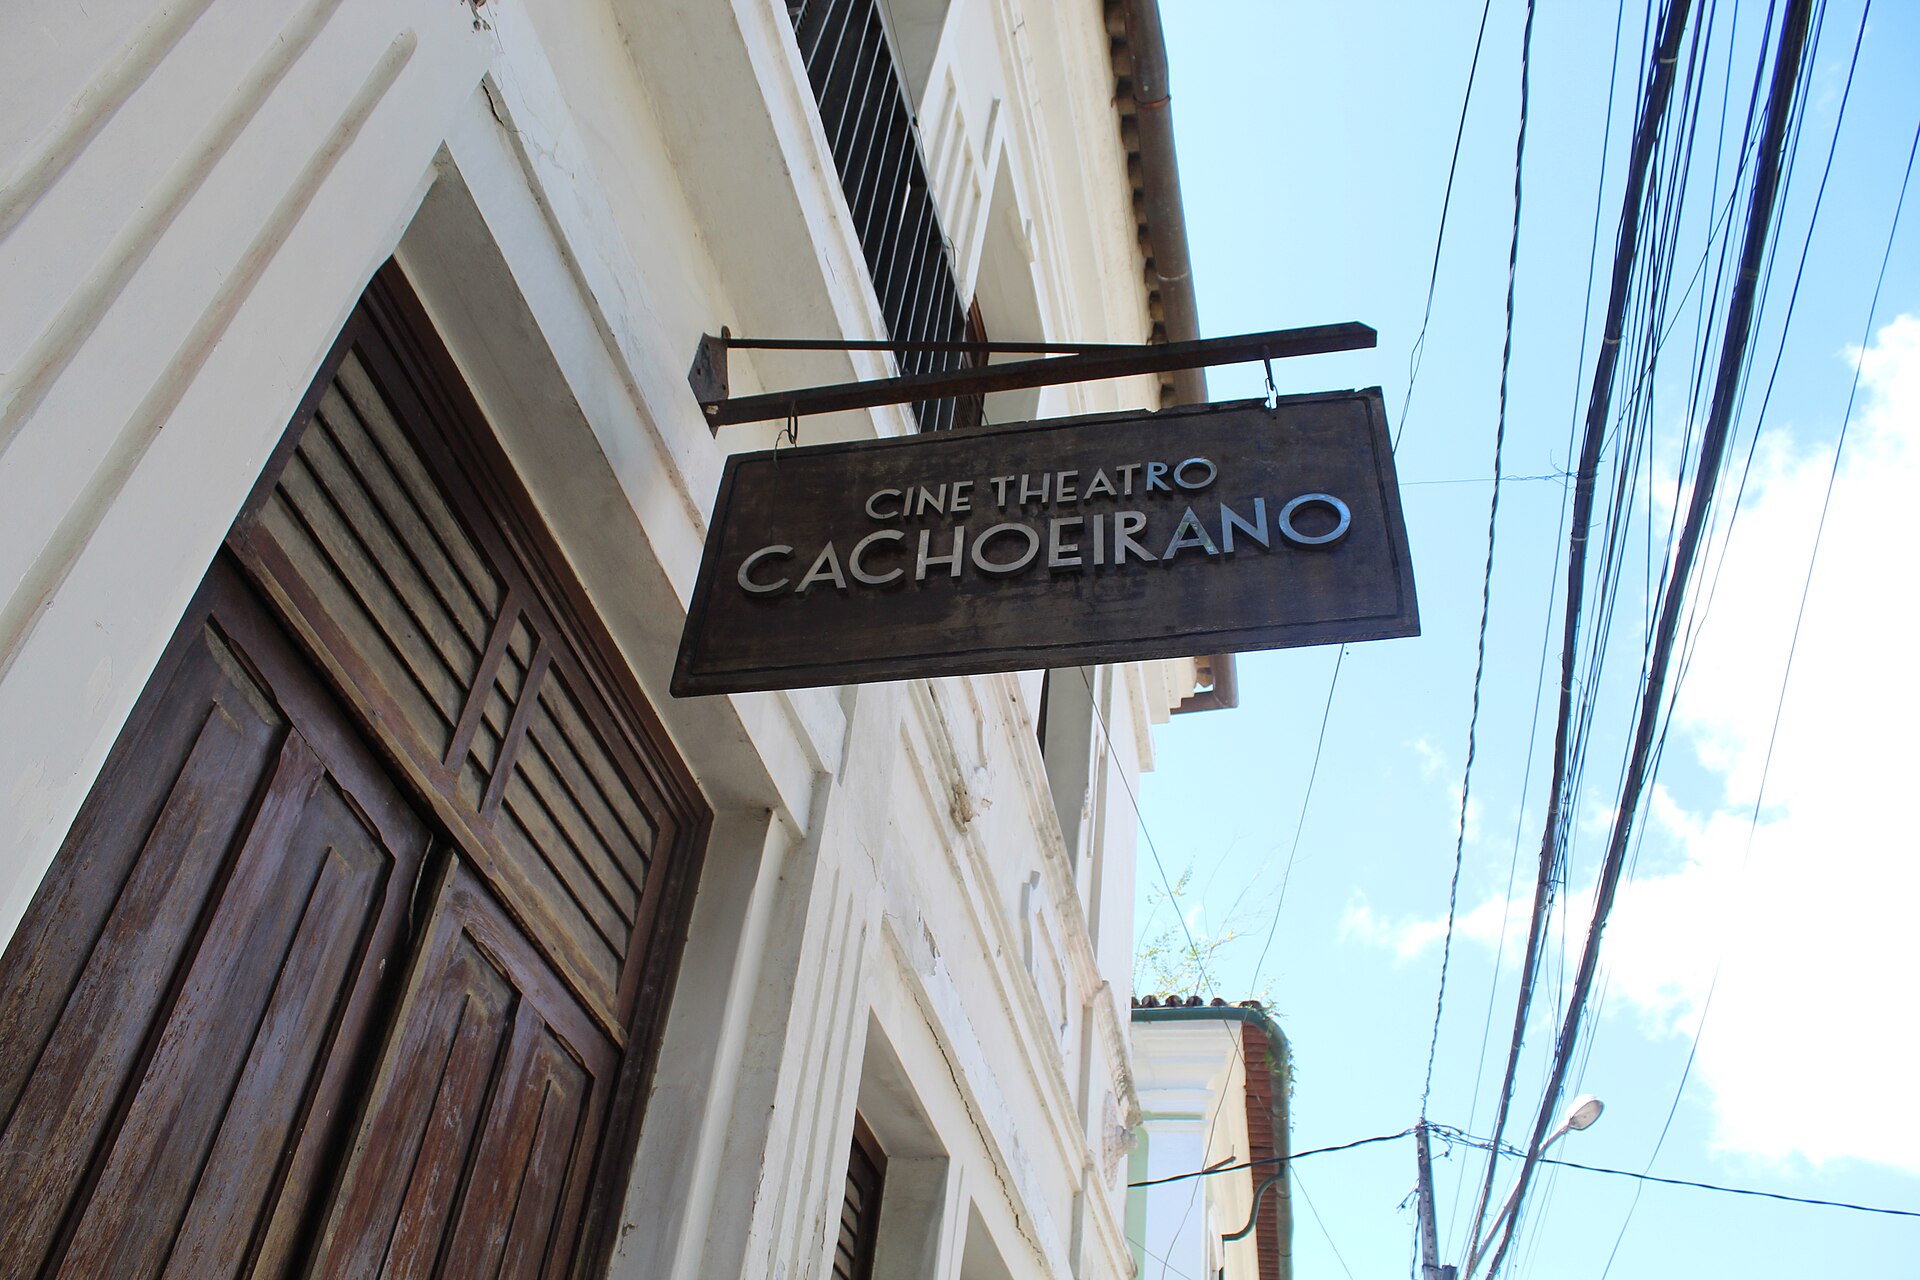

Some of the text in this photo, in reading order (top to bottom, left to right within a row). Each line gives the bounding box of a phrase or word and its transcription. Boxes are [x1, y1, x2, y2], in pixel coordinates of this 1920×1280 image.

[865, 457, 1219, 521] CINE THEATRO
[736, 493, 1353, 595] CACHOEIRANO
